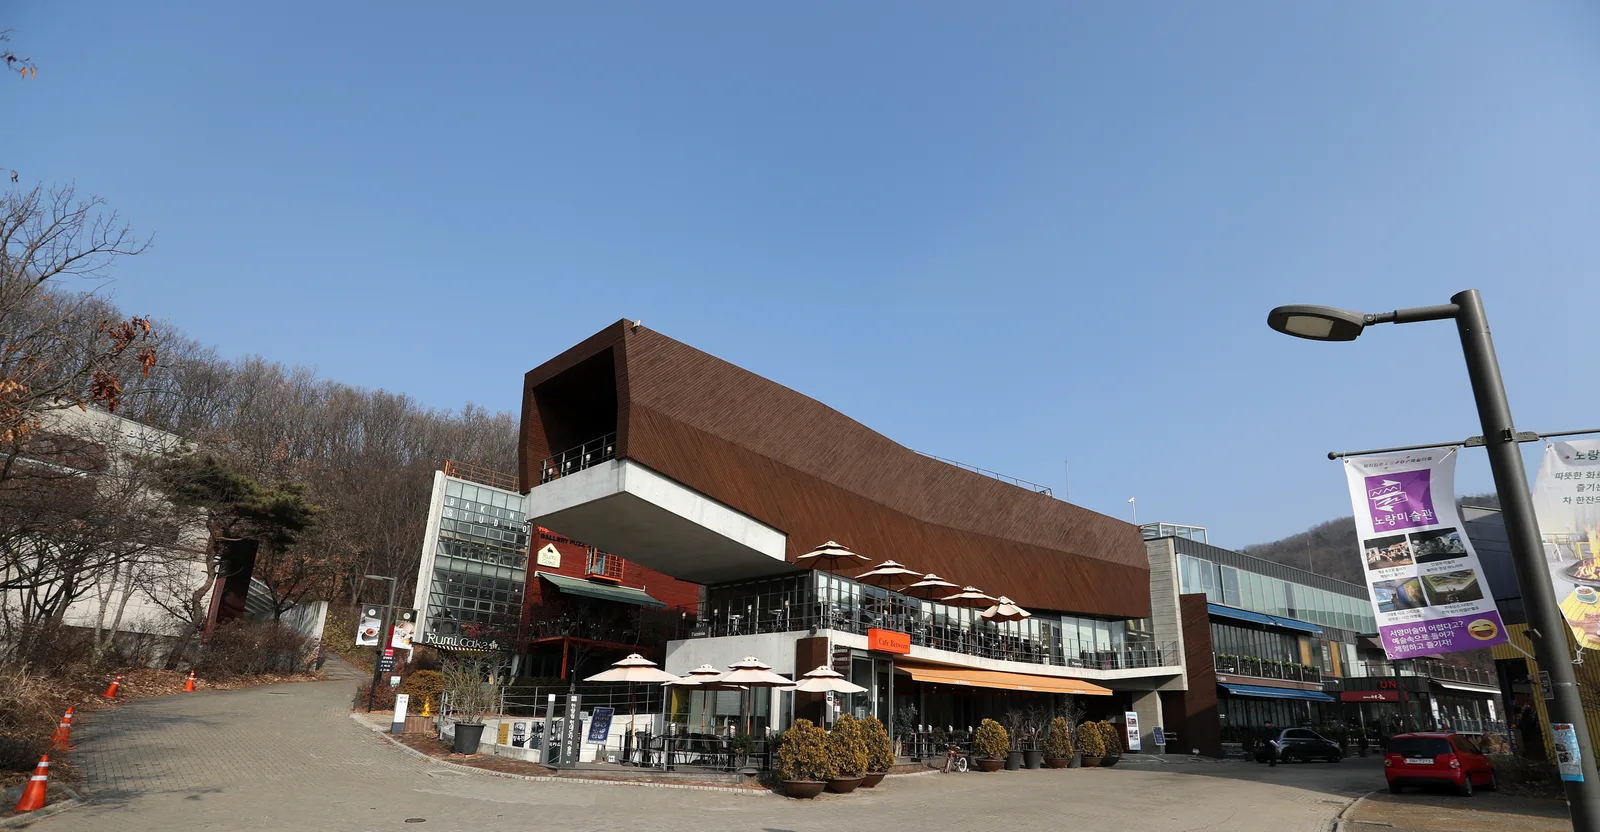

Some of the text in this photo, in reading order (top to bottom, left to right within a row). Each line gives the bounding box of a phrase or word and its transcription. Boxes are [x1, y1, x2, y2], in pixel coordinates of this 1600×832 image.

[1555, 471, 1582, 480] 따뜻한
[1562, 496, 1572, 505] 차
[448, 509, 527, 533] STUDIO
[1374, 508, 1434, 526] 노랑미술관
[540, 533, 569, 544] GALLERY
[1390, 620, 1464, 636] 서양미술이 어렵다고?
[425, 632, 488, 649] Rumi Cake
[878, 637, 909, 650] Cafe Between
[1391, 630, 1455, 645] 예술속으로 들어가
[1394, 639, 1453, 653] 체험하고 즐기자!
